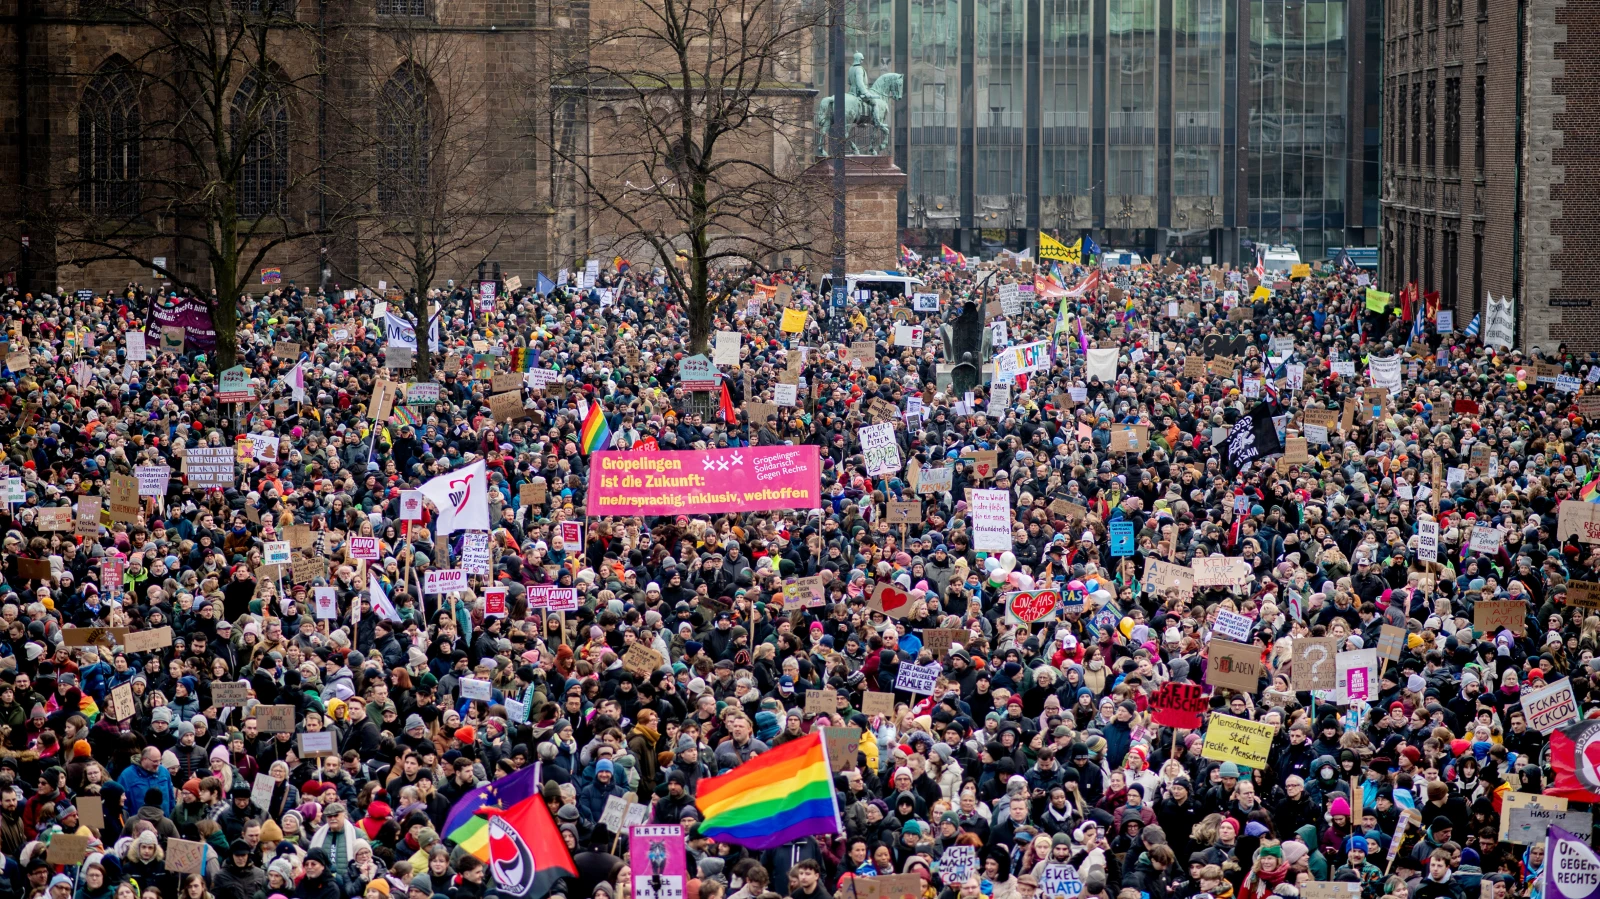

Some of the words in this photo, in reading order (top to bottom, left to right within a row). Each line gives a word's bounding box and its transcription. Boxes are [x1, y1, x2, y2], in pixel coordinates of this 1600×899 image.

[174, 301, 194, 313] Rechts
[194, 305, 208, 314] hilft
[1016, 344, 1045, 368] NICHT
[868, 431, 886, 440] NAZIS
[187, 448, 214, 456] NICHT
[217, 448, 233, 456] MAL
[602, 456, 682, 472] Gröpelingen
[753, 451, 801, 466] Gröpelingen:
[142, 466, 162, 474] Immer
[754, 459, 794, 474] Solidarisch
[757, 471, 780, 482] Gegen
[782, 465, 808, 476] Rechts
[600, 475, 618, 488] ist
[622, 474, 642, 488] die
[645, 474, 706, 488] Zukunft:
[599, 494, 686, 508] mehrsprachig,
[688, 491, 741, 505] inklusiv,
[744, 488, 809, 502] weltoffen
[1422, 524, 1435, 534] OMAS
[352, 540, 374, 548] AWO
[1420, 536, 1436, 547] GEGEN
[1418, 548, 1437, 560] RECHTS
[1204, 558, 1230, 567] KEIN
[1204, 566, 1234, 574] MERZ
[1214, 572, 1227, 580] IM
[438, 572, 461, 581] AWO
[1146, 573, 1165, 586] Fall
[550, 590, 572, 600] AWO
[1013, 597, 1032, 608] LOVE
[1036, 595, 1054, 606] HAS
[1018, 608, 1046, 621] COLOR
[1492, 608, 1514, 616] AUF
[1486, 616, 1524, 627] NAZIS!
[631, 642, 648, 656] Excuse
[1162, 684, 1200, 698] SEID
[1151, 696, 1209, 713] MENSCHEN
[1529, 690, 1572, 715] FCKAFD
[258, 707, 292, 716] ZUSAMMEN
[1533, 702, 1576, 729] FCKCDU
[1210, 714, 1272, 738] Menschenrechte
[1205, 740, 1228, 753] rechte
[1231, 746, 1266, 764] Menschen
[608, 800, 624, 811] NACH
[629, 806, 642, 817] DER
[1530, 810, 1550, 819] HASS
[1556, 812, 1567, 820] ist
[636, 826, 680, 836] KATZIS
[948, 848, 968, 858] ICH
[940, 857, 973, 867] MACHS
[1046, 868, 1078, 880] EKEL
[1558, 872, 1598, 886] RECHTS
